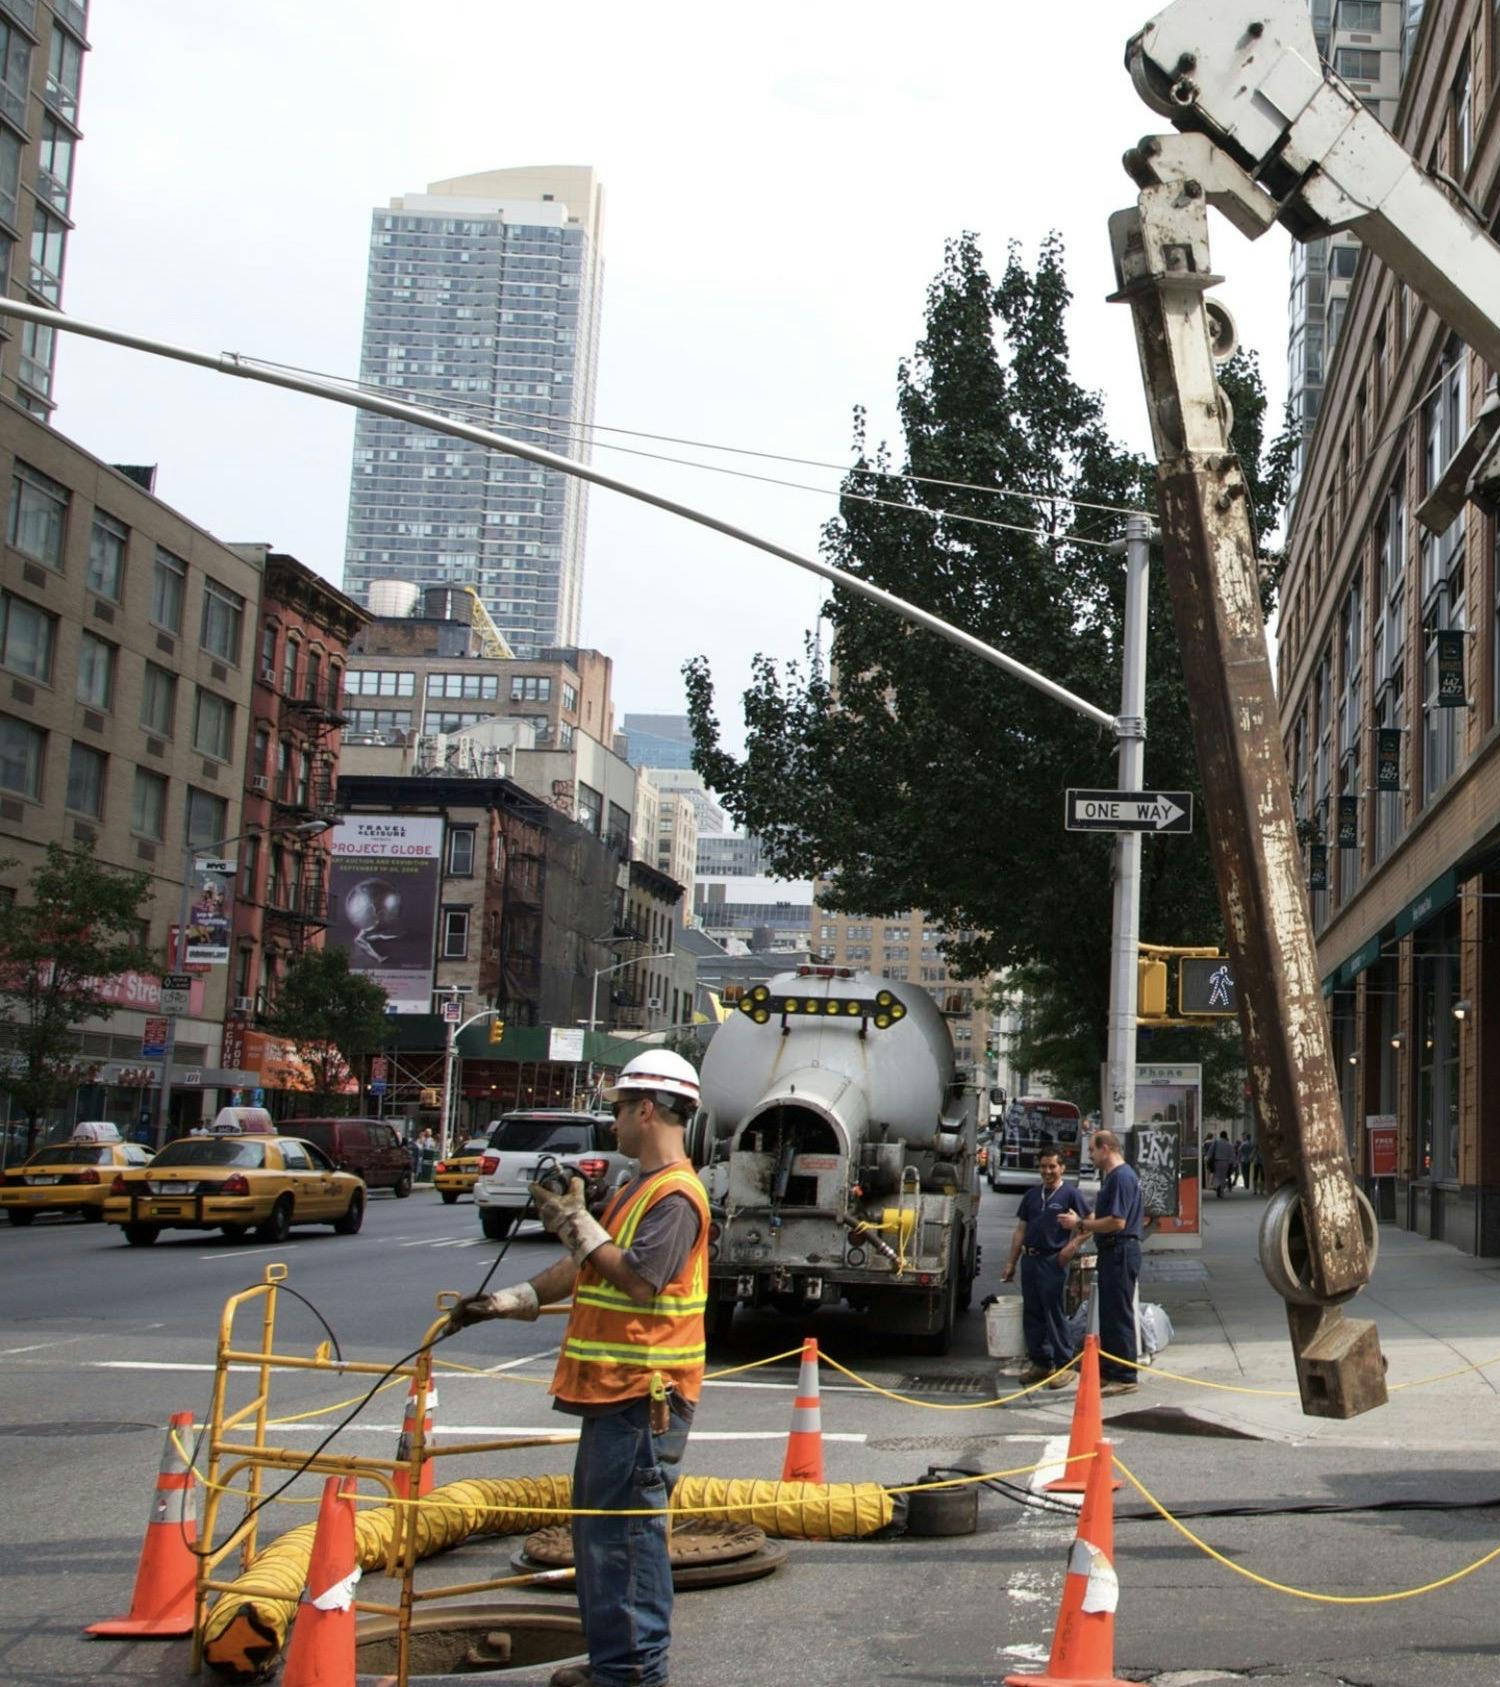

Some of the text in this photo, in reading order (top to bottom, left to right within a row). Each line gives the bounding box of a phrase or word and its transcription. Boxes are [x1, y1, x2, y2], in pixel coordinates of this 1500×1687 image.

[1085, 803, 1173, 820] ONE WAY
[331, 843, 432, 855] PROJECT GLOBE
[126, 975, 160, 1003] Stre
[233, 1041, 242, 1070] FOO
[1139, 1069, 1183, 1078] Phone
